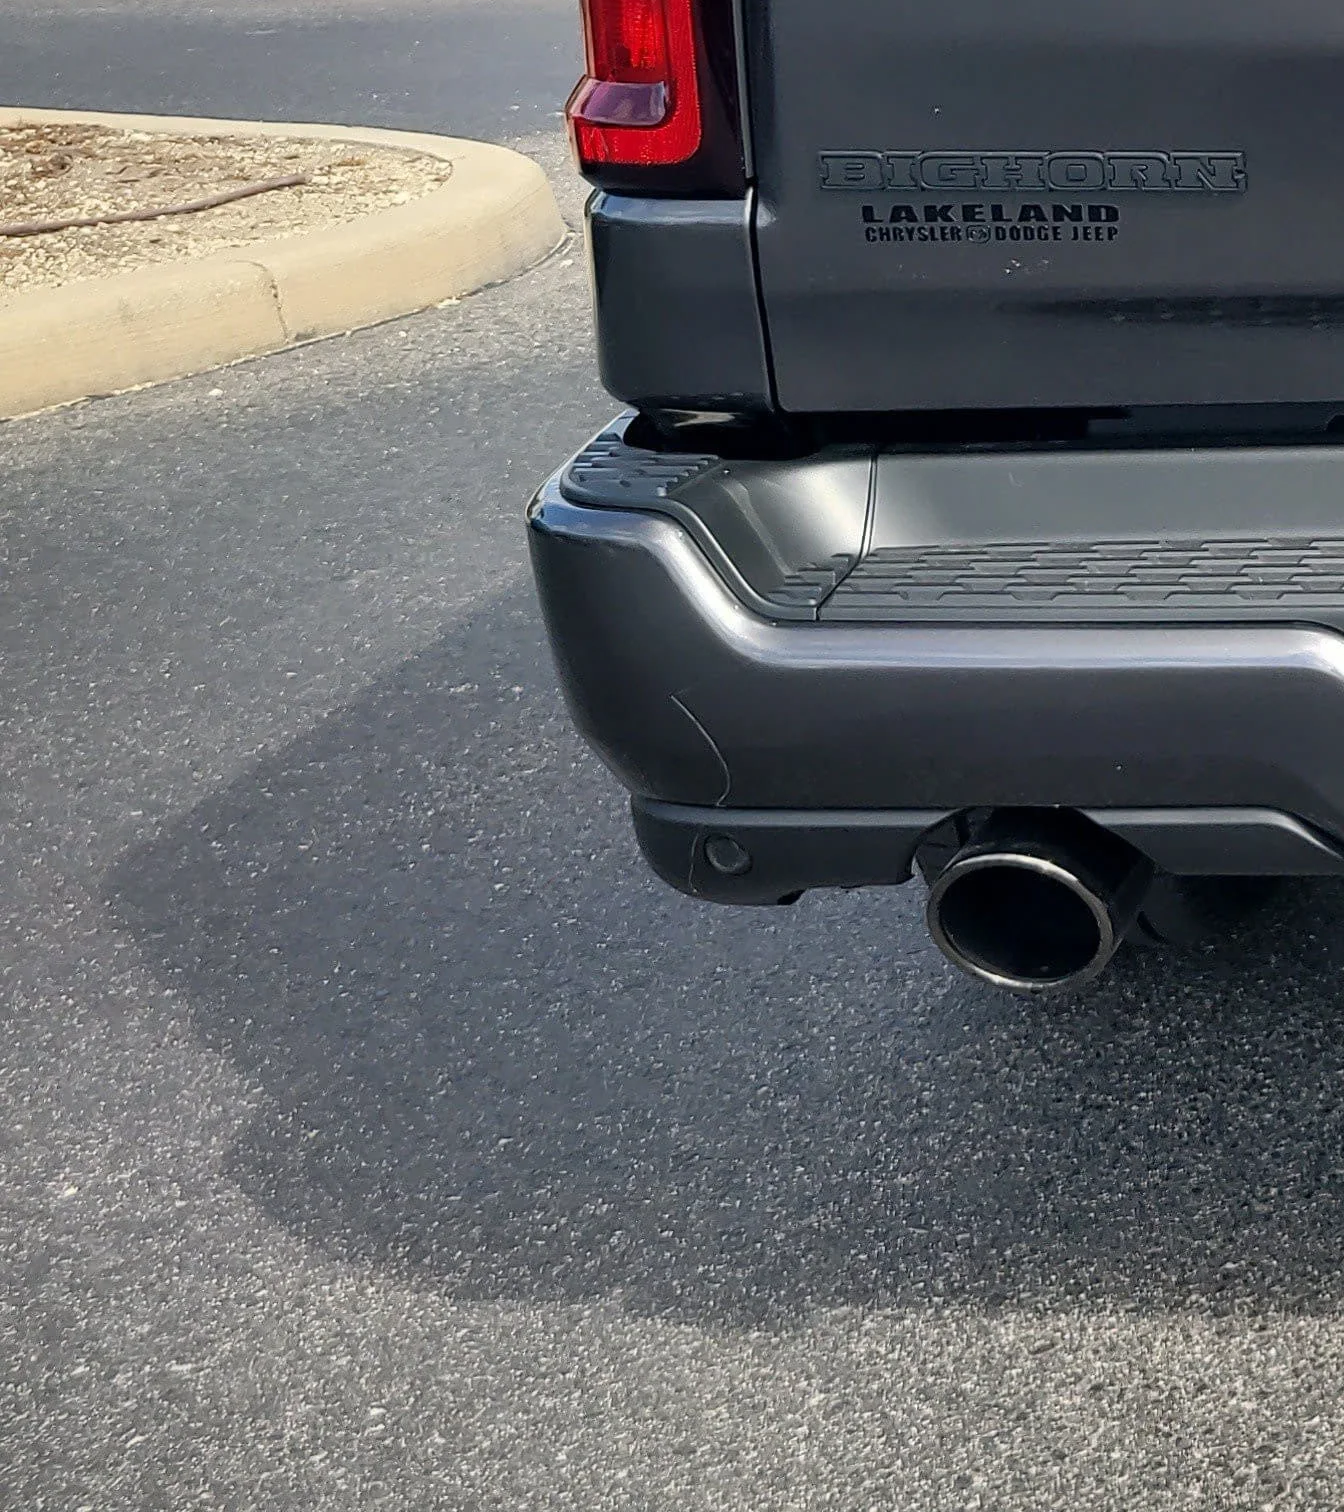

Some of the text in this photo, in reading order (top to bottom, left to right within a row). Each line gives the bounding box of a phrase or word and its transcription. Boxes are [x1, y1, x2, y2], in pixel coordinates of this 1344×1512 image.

[817, 149, 1248, 191] BIGHORN
[861, 203, 1120, 223] LAKELAND
[864, 224, 1119, 243] CHRYSLER DODGE JEEP
